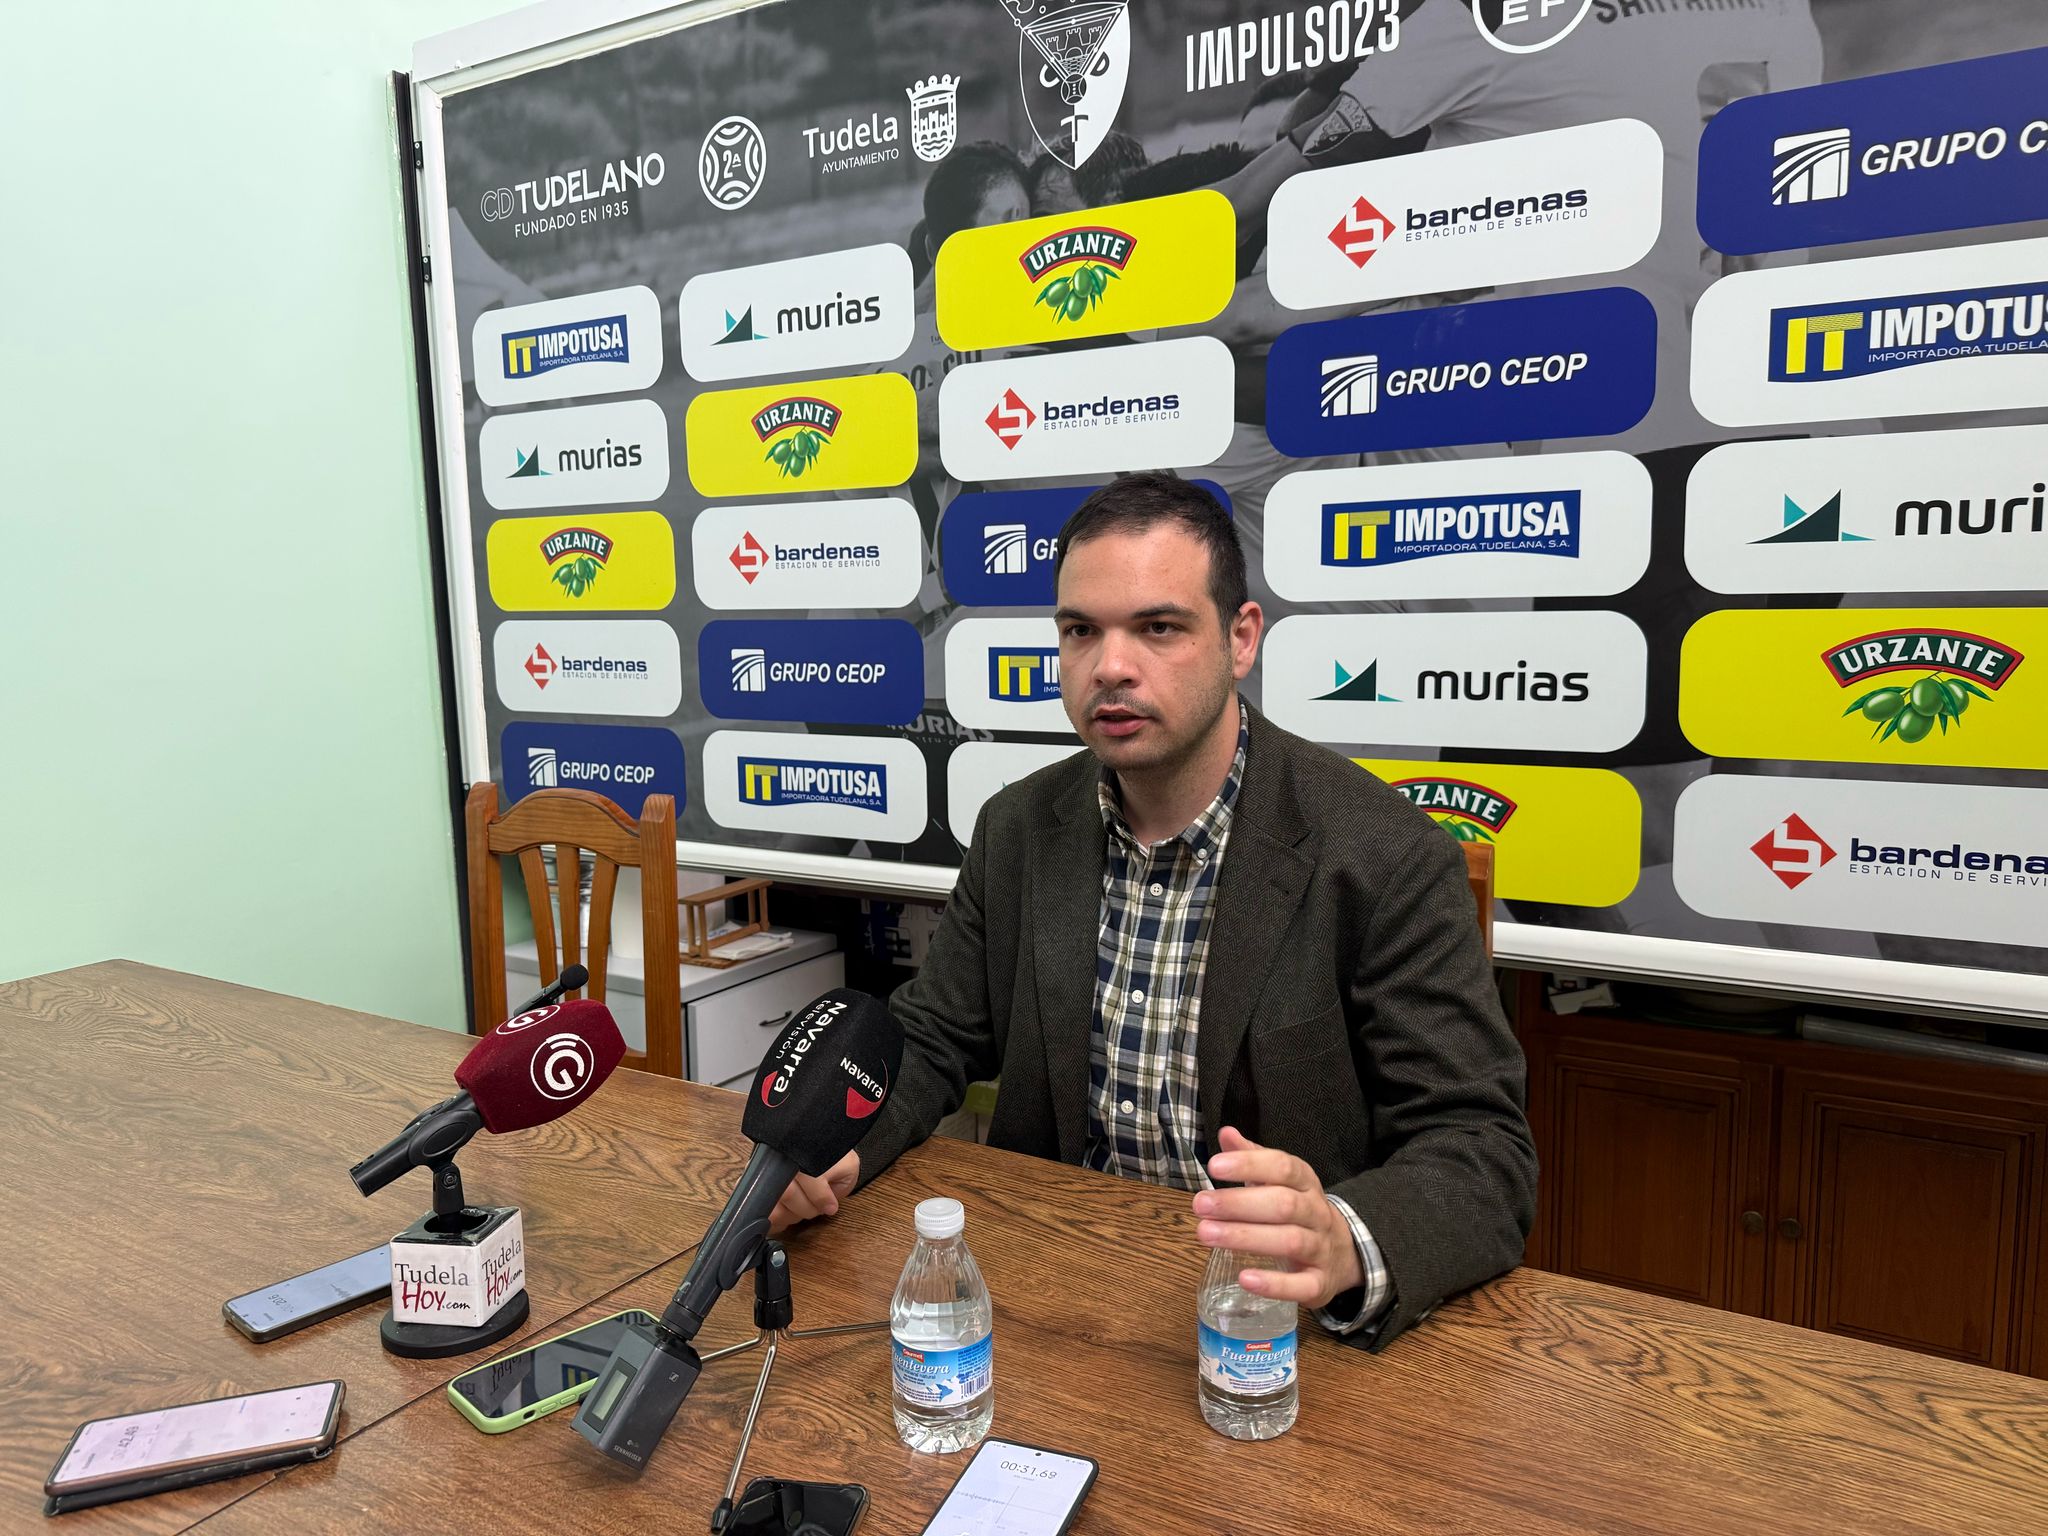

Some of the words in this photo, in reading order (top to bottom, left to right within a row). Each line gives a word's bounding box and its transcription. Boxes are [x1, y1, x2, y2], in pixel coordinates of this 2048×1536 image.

[1186, 0, 1401, 93] IMPULSO23
[802, 112, 899, 159] Tudela
[1861, 127, 2007, 176] GRUPO
[822, 148, 899, 174] AYUNTAMIENTO
[481, 187, 514, 222] CD
[515, 152, 665, 214] TUDELANO
[515, 212, 576, 238] FUNDADO
[580, 206, 597, 225] EN
[602, 200, 629, 220] 1935
[1406, 189, 1588, 231] bardenas
[1406, 225, 1477, 243] ESTACION
[1487, 220, 1504, 230] DE
[1514, 208, 1588, 227] SERVICIO
[1029, 232, 1126, 272] URZANTE
[777, 291, 881, 335] murias
[508, 336, 536, 374] IT
[538, 323, 623, 359] IMPOTUSA
[1786, 312, 1864, 374] IT
[1868, 345, 1981, 363] IMPORTADORA
[540, 357, 580, 367] IMPORTADORA
[1385, 362, 1491, 397] GRUPO
[1500, 352, 1588, 386] CEOP
[759, 402, 834, 434] URZANTE
[1044, 394, 1180, 421] bardenas
[1044, 419, 1097, 430] ESTACION
[1105, 416, 1118, 425] DE
[1125, 411, 1180, 424] SERVICIO
[558, 439, 642, 472] murias
[546, 530, 607, 556] URZANTE
[1333, 510, 1390, 560] IT
[1395, 501, 1569, 542] IMPOTUSA
[1394, 543, 1478, 554] IMPORTADORA
[1479, 541, 1546, 552] TUDELANA,
[1549, 540, 1570, 548] S.A.
[775, 543, 880, 561] bardenas
[775, 559, 818, 570] ESTACION
[822, 560, 834, 568] DE
[838, 559, 881, 568] SERVICIO
[562, 656, 647, 672] bardenas
[769, 662, 830, 685] GRUPO
[836, 663, 886, 685] CEOP
[1839, 637, 2003, 678] URZANTE
[1418, 660, 1589, 702] murias
[560, 761, 610, 781] GRUPO
[614, 765, 655, 784] CEOP
[745, 764, 778, 800] IT
[781, 766, 881, 797] IMPOTUSA
[781, 793, 829, 802] IMPORTADORA
[1397, 785, 1503, 821] ZANTE
[1849, 864, 1941, 880] ESTACION
[1954, 871, 1976, 881] DE
[774, 1001, 847, 1092] Navarra
[776, 999, 831, 1059] televisión
[840, 1057, 883, 1098] Navarra
[395, 1263, 469, 1286] Tudela
[482, 1239, 521, 1281] Tudela
[1221, 1346, 1291, 1362] Fuentevera
